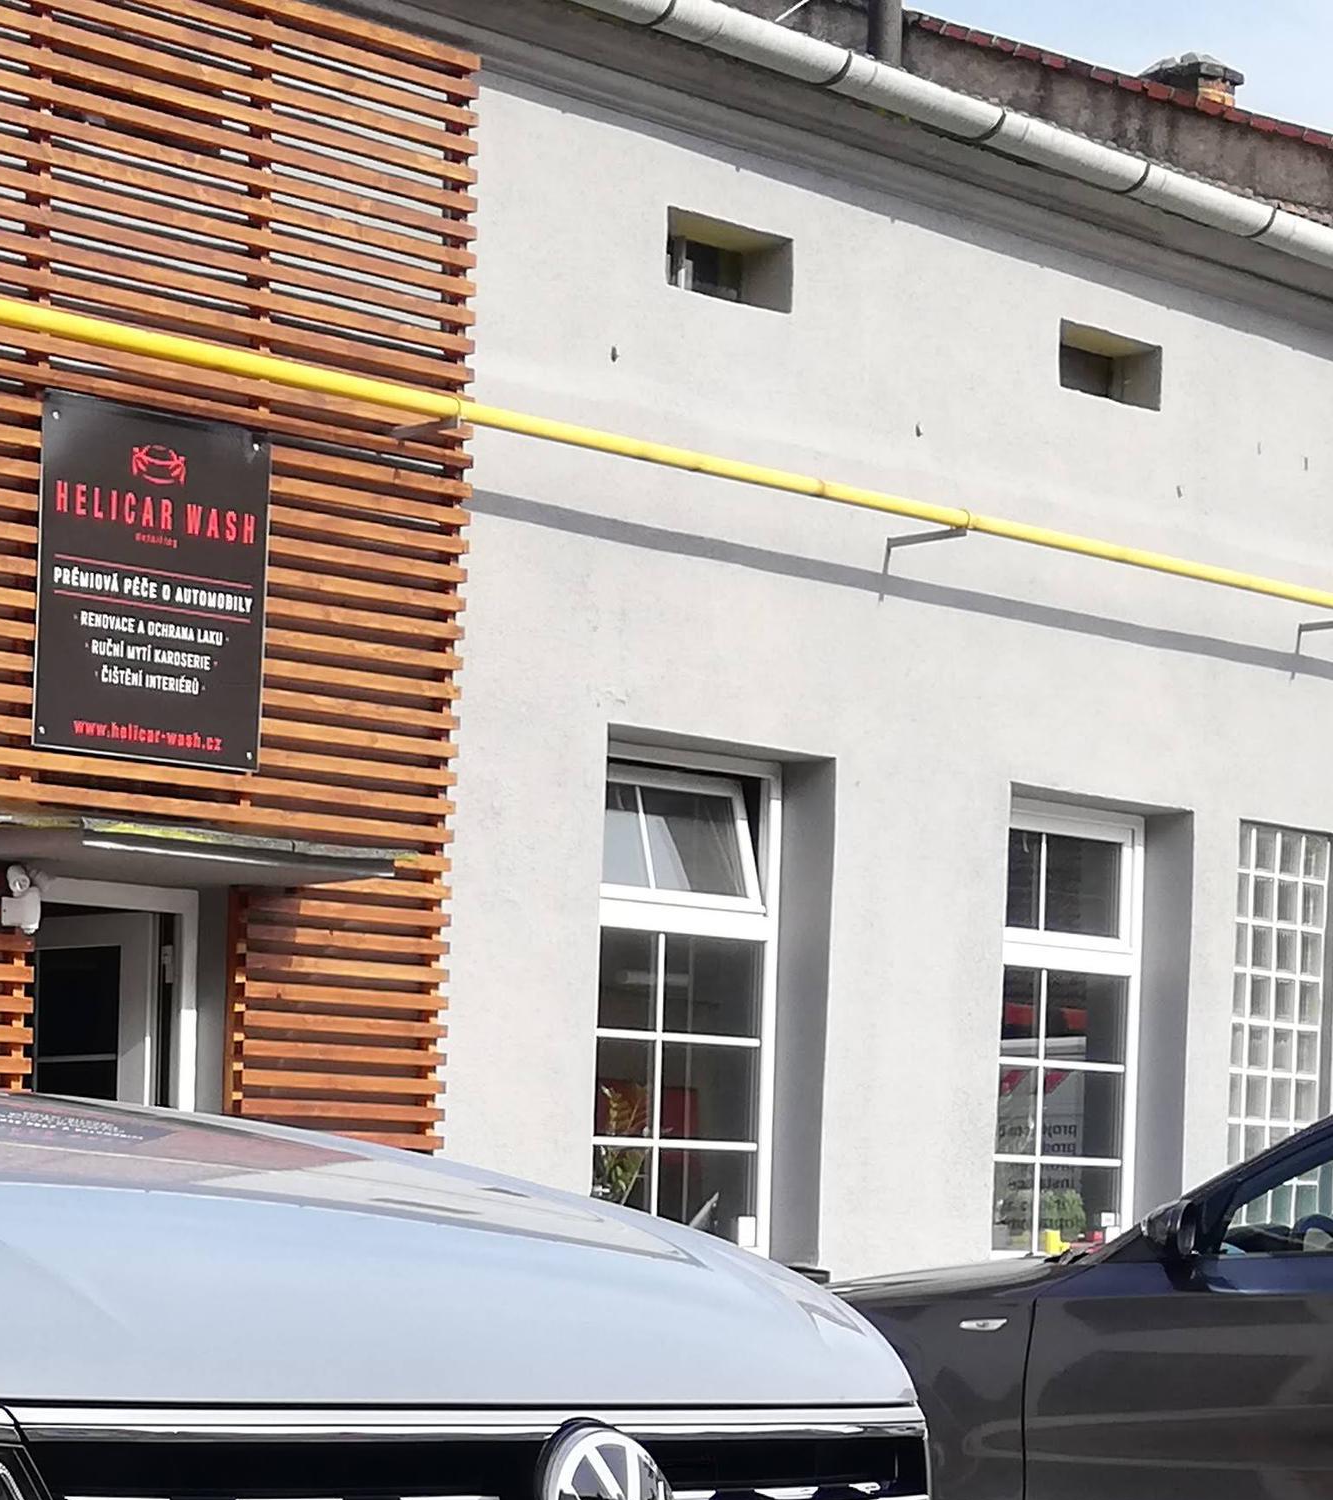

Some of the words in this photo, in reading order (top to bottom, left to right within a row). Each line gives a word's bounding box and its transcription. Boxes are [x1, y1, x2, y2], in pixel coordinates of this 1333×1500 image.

[55, 480, 173, 531] HELICAR
[186, 503, 256, 545] WASH
[53, 566, 119, 593] PRÉMIOVÁ
[124, 575, 158, 599] PÉČE
[162, 584, 171, 601] O
[175, 586, 253, 614] AUTOMOBILY
[80, 610, 136, 634] RENOVACE
[137, 621, 145, 634] A
[147, 620, 195, 642] OCHRANA
[197, 628, 223, 647] LAKU
[91, 638, 124, 658] RUČNÍ
[126, 644, 152, 662] MYTÍ
[153, 649, 211, 671] KAROSERIE
[101, 664, 143, 687] ČIŠTĚNÍ
[145, 673, 200, 696] INTERIÉRŮ
[73, 719, 222, 752] www.helicar-wash.cz
